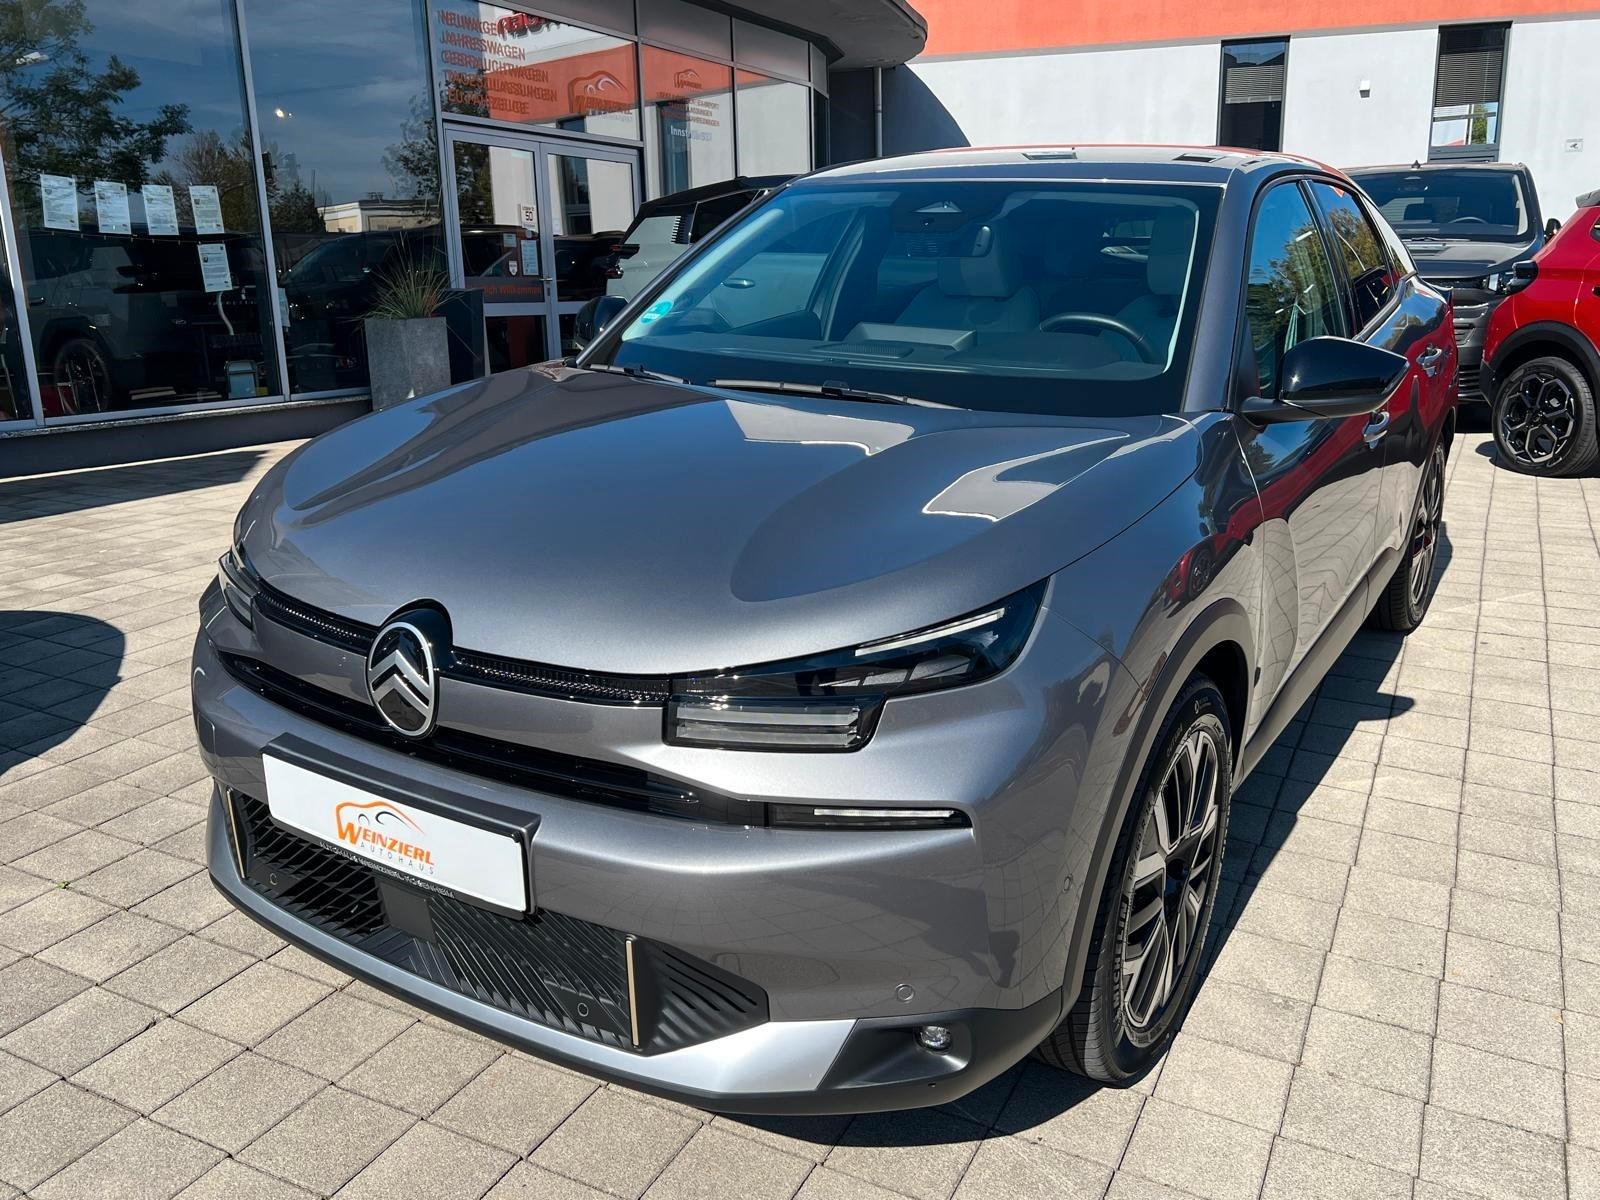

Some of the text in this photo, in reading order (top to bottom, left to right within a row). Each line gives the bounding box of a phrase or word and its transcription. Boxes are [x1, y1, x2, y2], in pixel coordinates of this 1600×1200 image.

[441, 29, 526, 60] JAHRESWAGEN
[337, 822, 434, 866] WEINZIERL
[360, 841, 434, 875] AUTOHAUS
[1112, 901, 1129, 1009] MICHELIN
